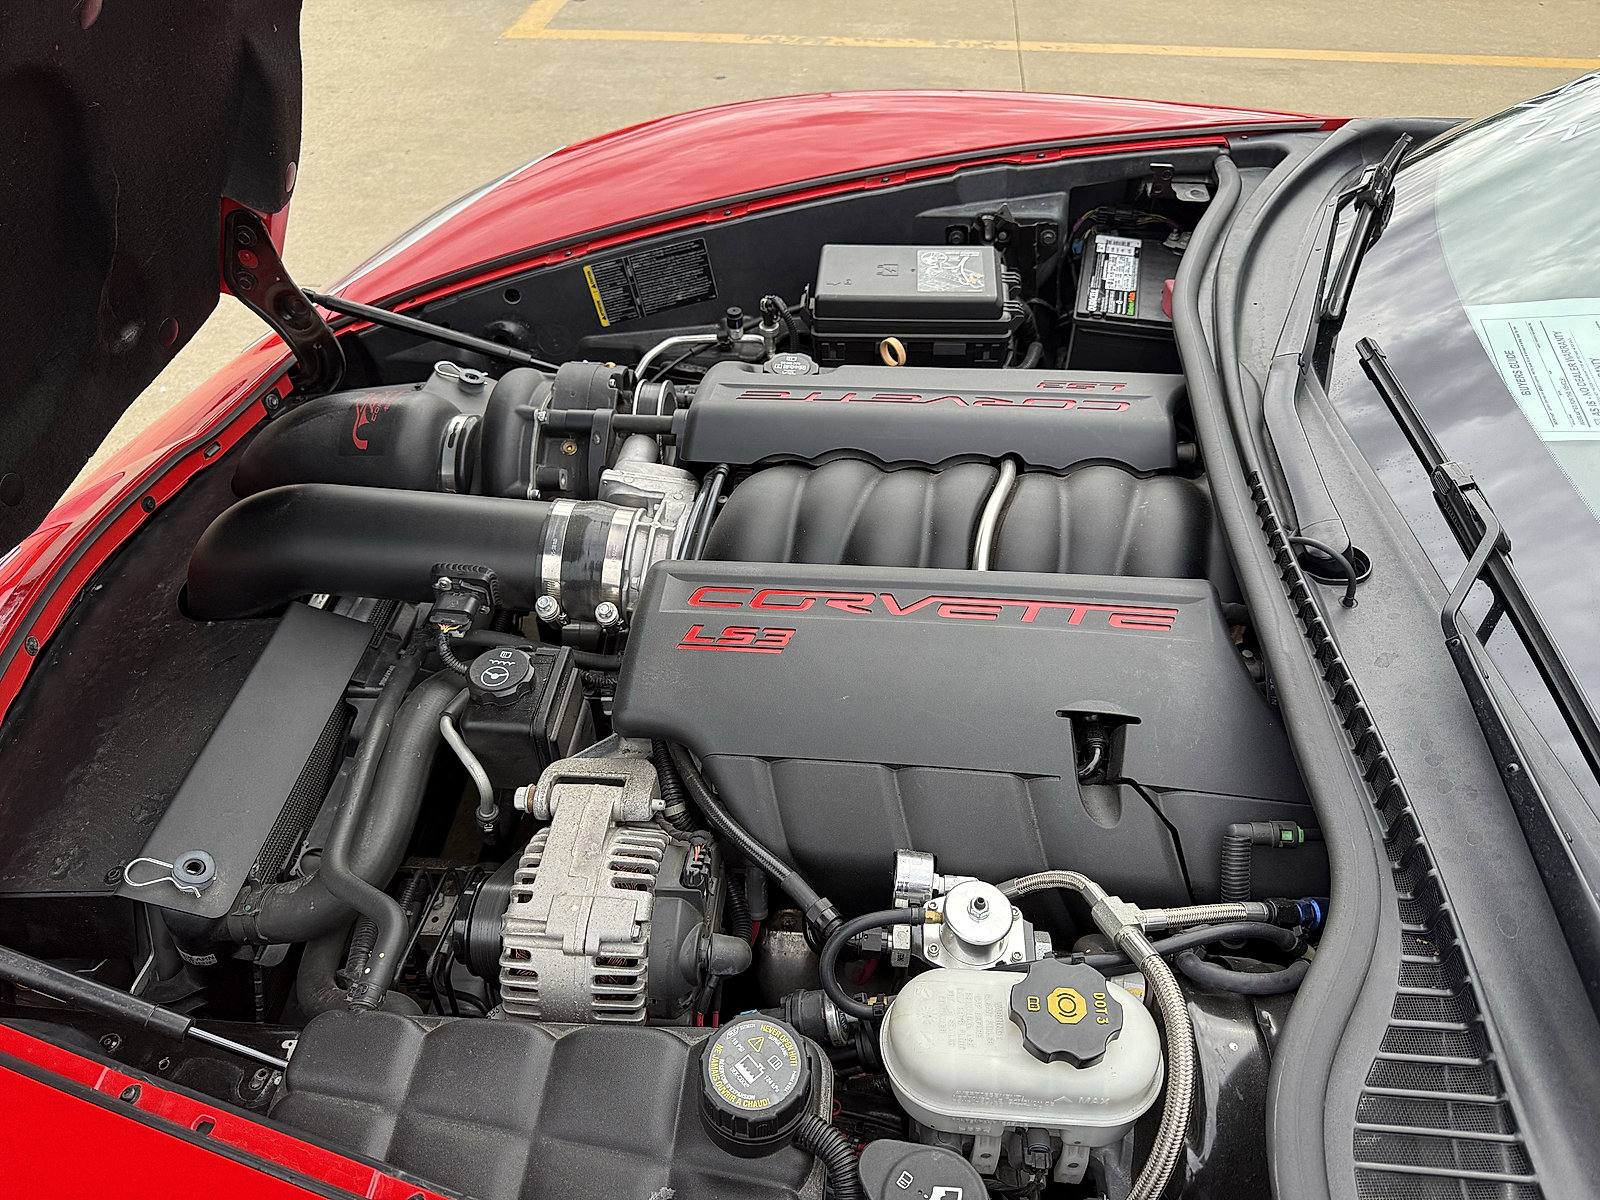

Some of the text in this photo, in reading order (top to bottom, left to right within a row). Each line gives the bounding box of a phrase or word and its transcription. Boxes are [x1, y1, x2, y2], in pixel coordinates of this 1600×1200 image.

[1552, 330, 1574, 362] WARRANTY
[1504, 350, 1532, 396] BUYERS GUIDE
[1568, 362, 1587, 387] DEALER
[736, 390, 1131, 412] CORVETTE
[688, 586, 1179, 632] CORVETTE
[680, 624, 796, 648] LS3
[1092, 992, 1110, 1025] DOT 3
[714, 1044, 724, 1054] NE
[736, 1043, 746, 1053] PSI
[760, 1024, 782, 1038] NEVER
[780, 1034, 794, 1052] OPEN
[788, 1050, 798, 1067] HOT!
[768, 1034, 789, 1058] SURGE TANK
[710, 1054, 720, 1082] JAMAIS
[764, 1074, 772, 1085] 124
[715, 1080, 737, 1102] OUVRIR
[742, 1098, 771, 1108] CHAUD!
